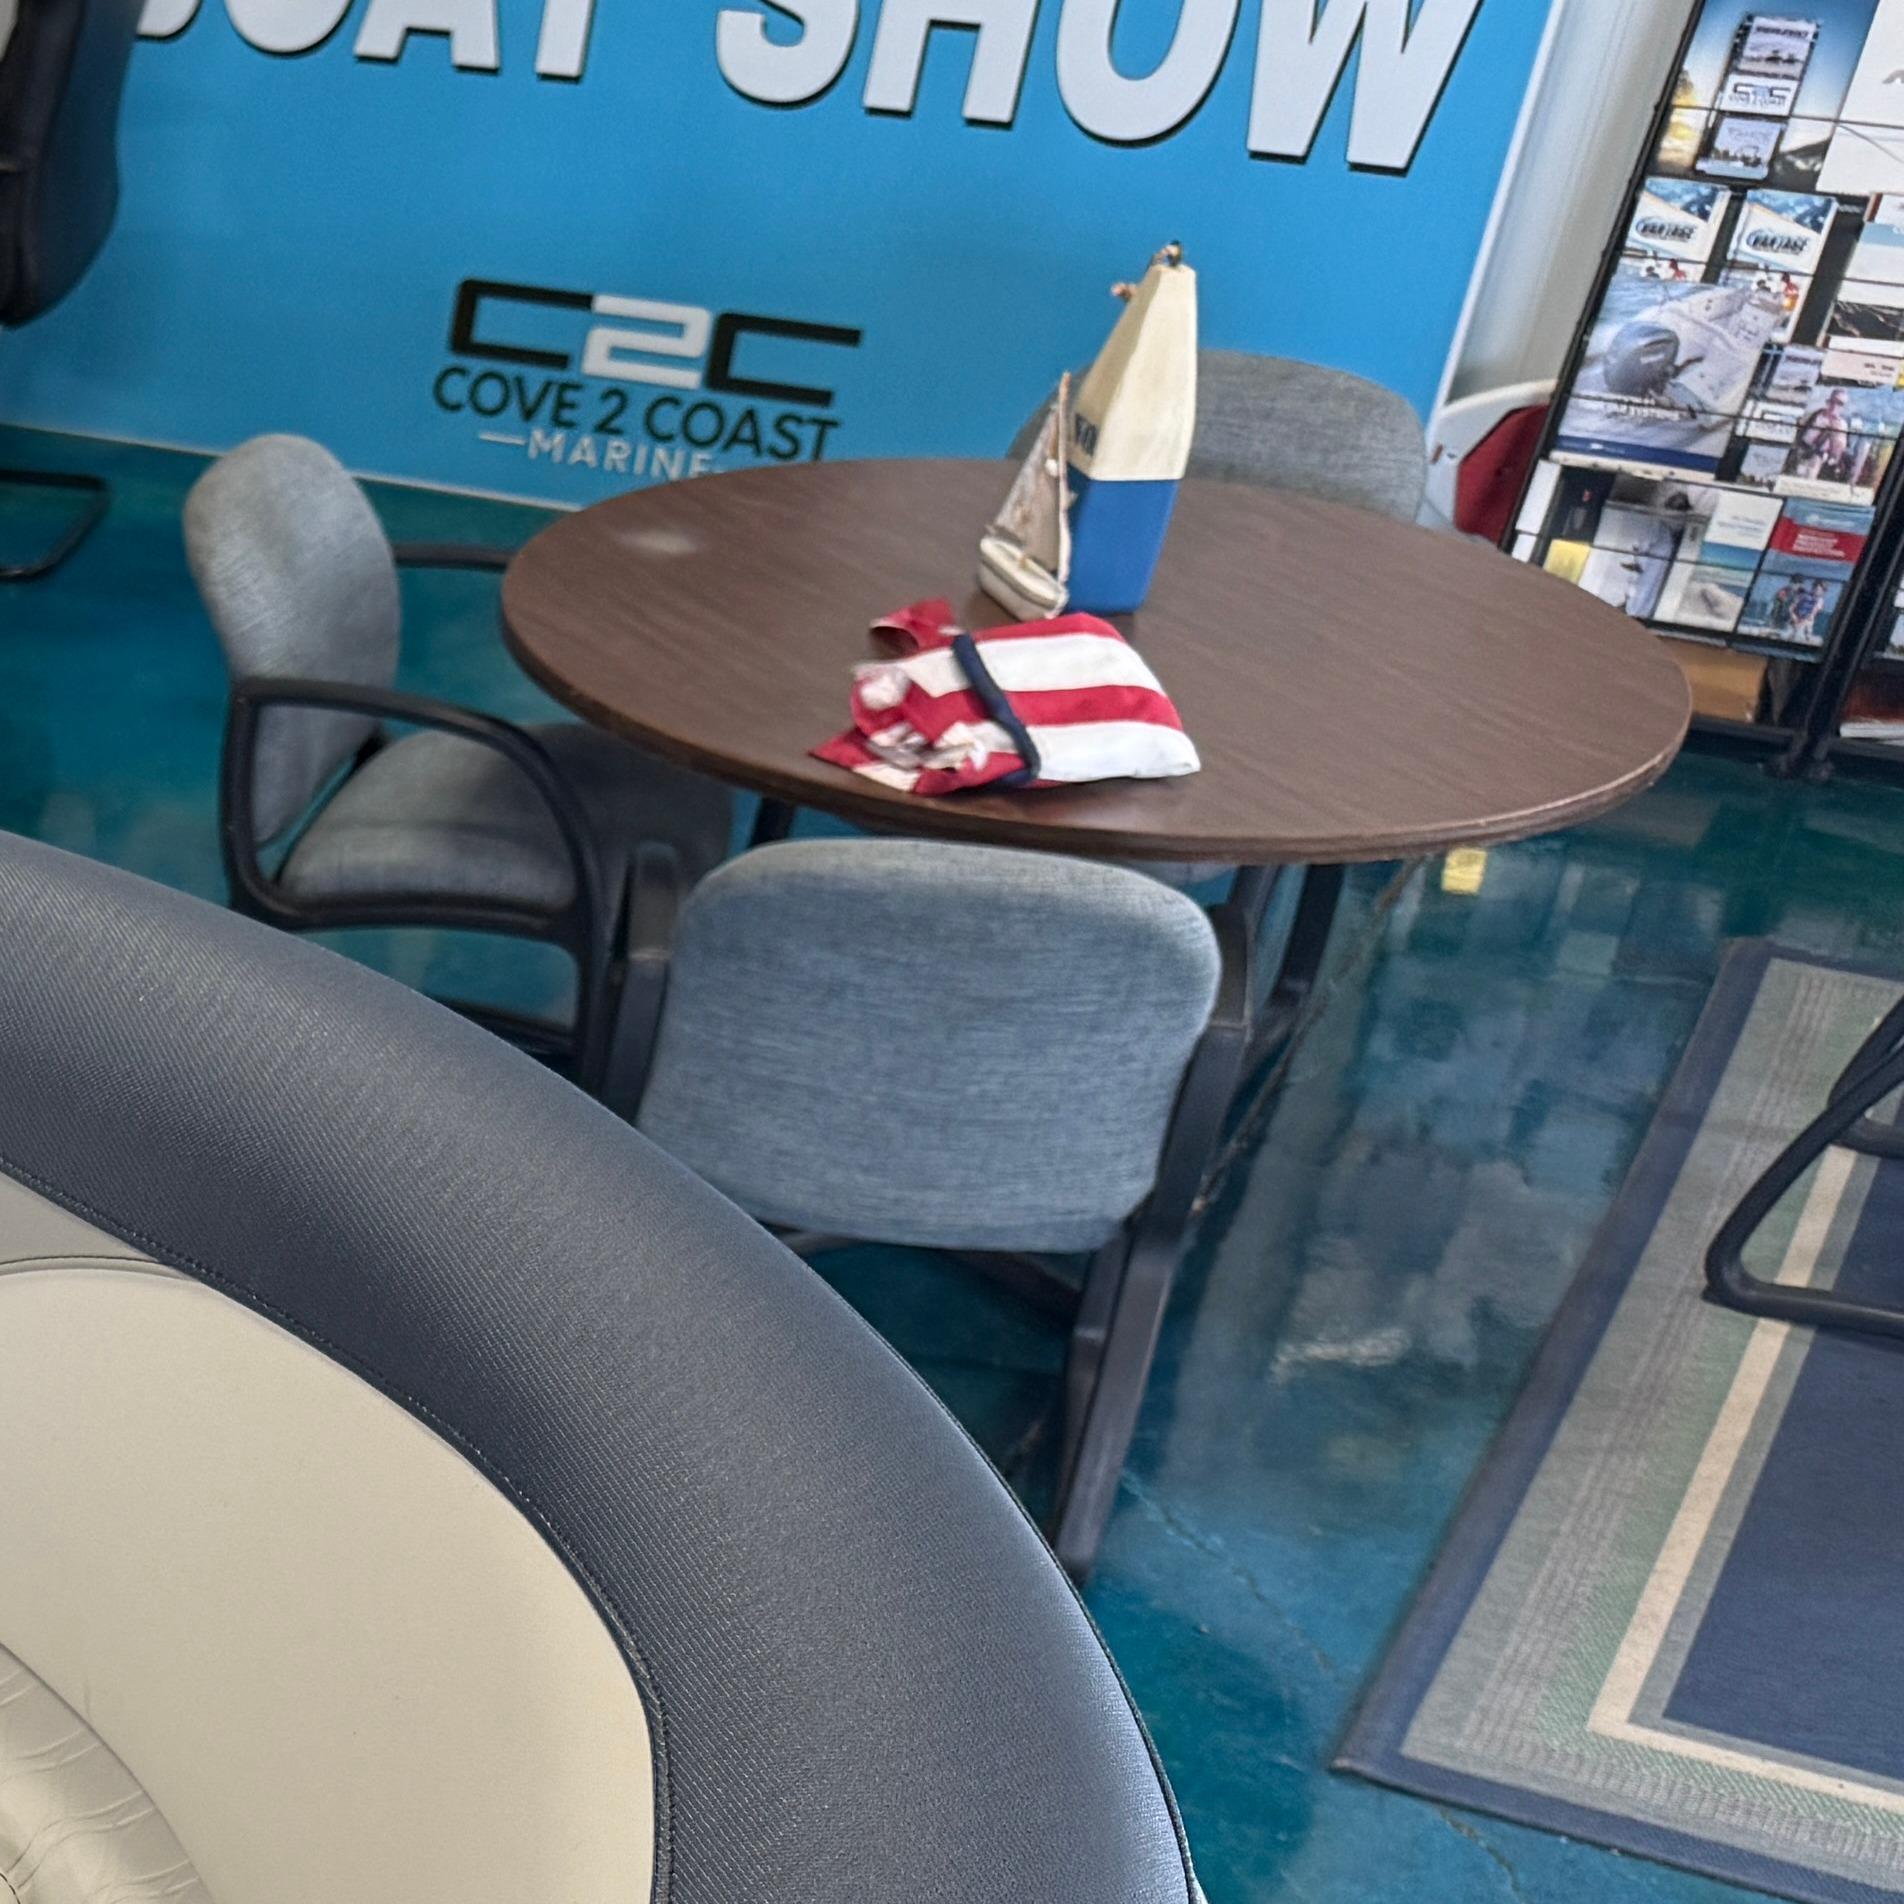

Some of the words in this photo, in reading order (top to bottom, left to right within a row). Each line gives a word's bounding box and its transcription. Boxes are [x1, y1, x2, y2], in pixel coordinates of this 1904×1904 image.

[448, 278, 863, 408] C2C
[432, 366, 584, 429] COVE
[594, 387, 629, 437] 2
[643, 395, 842, 462] COAST
[526, 428, 715, 481] MARINE
